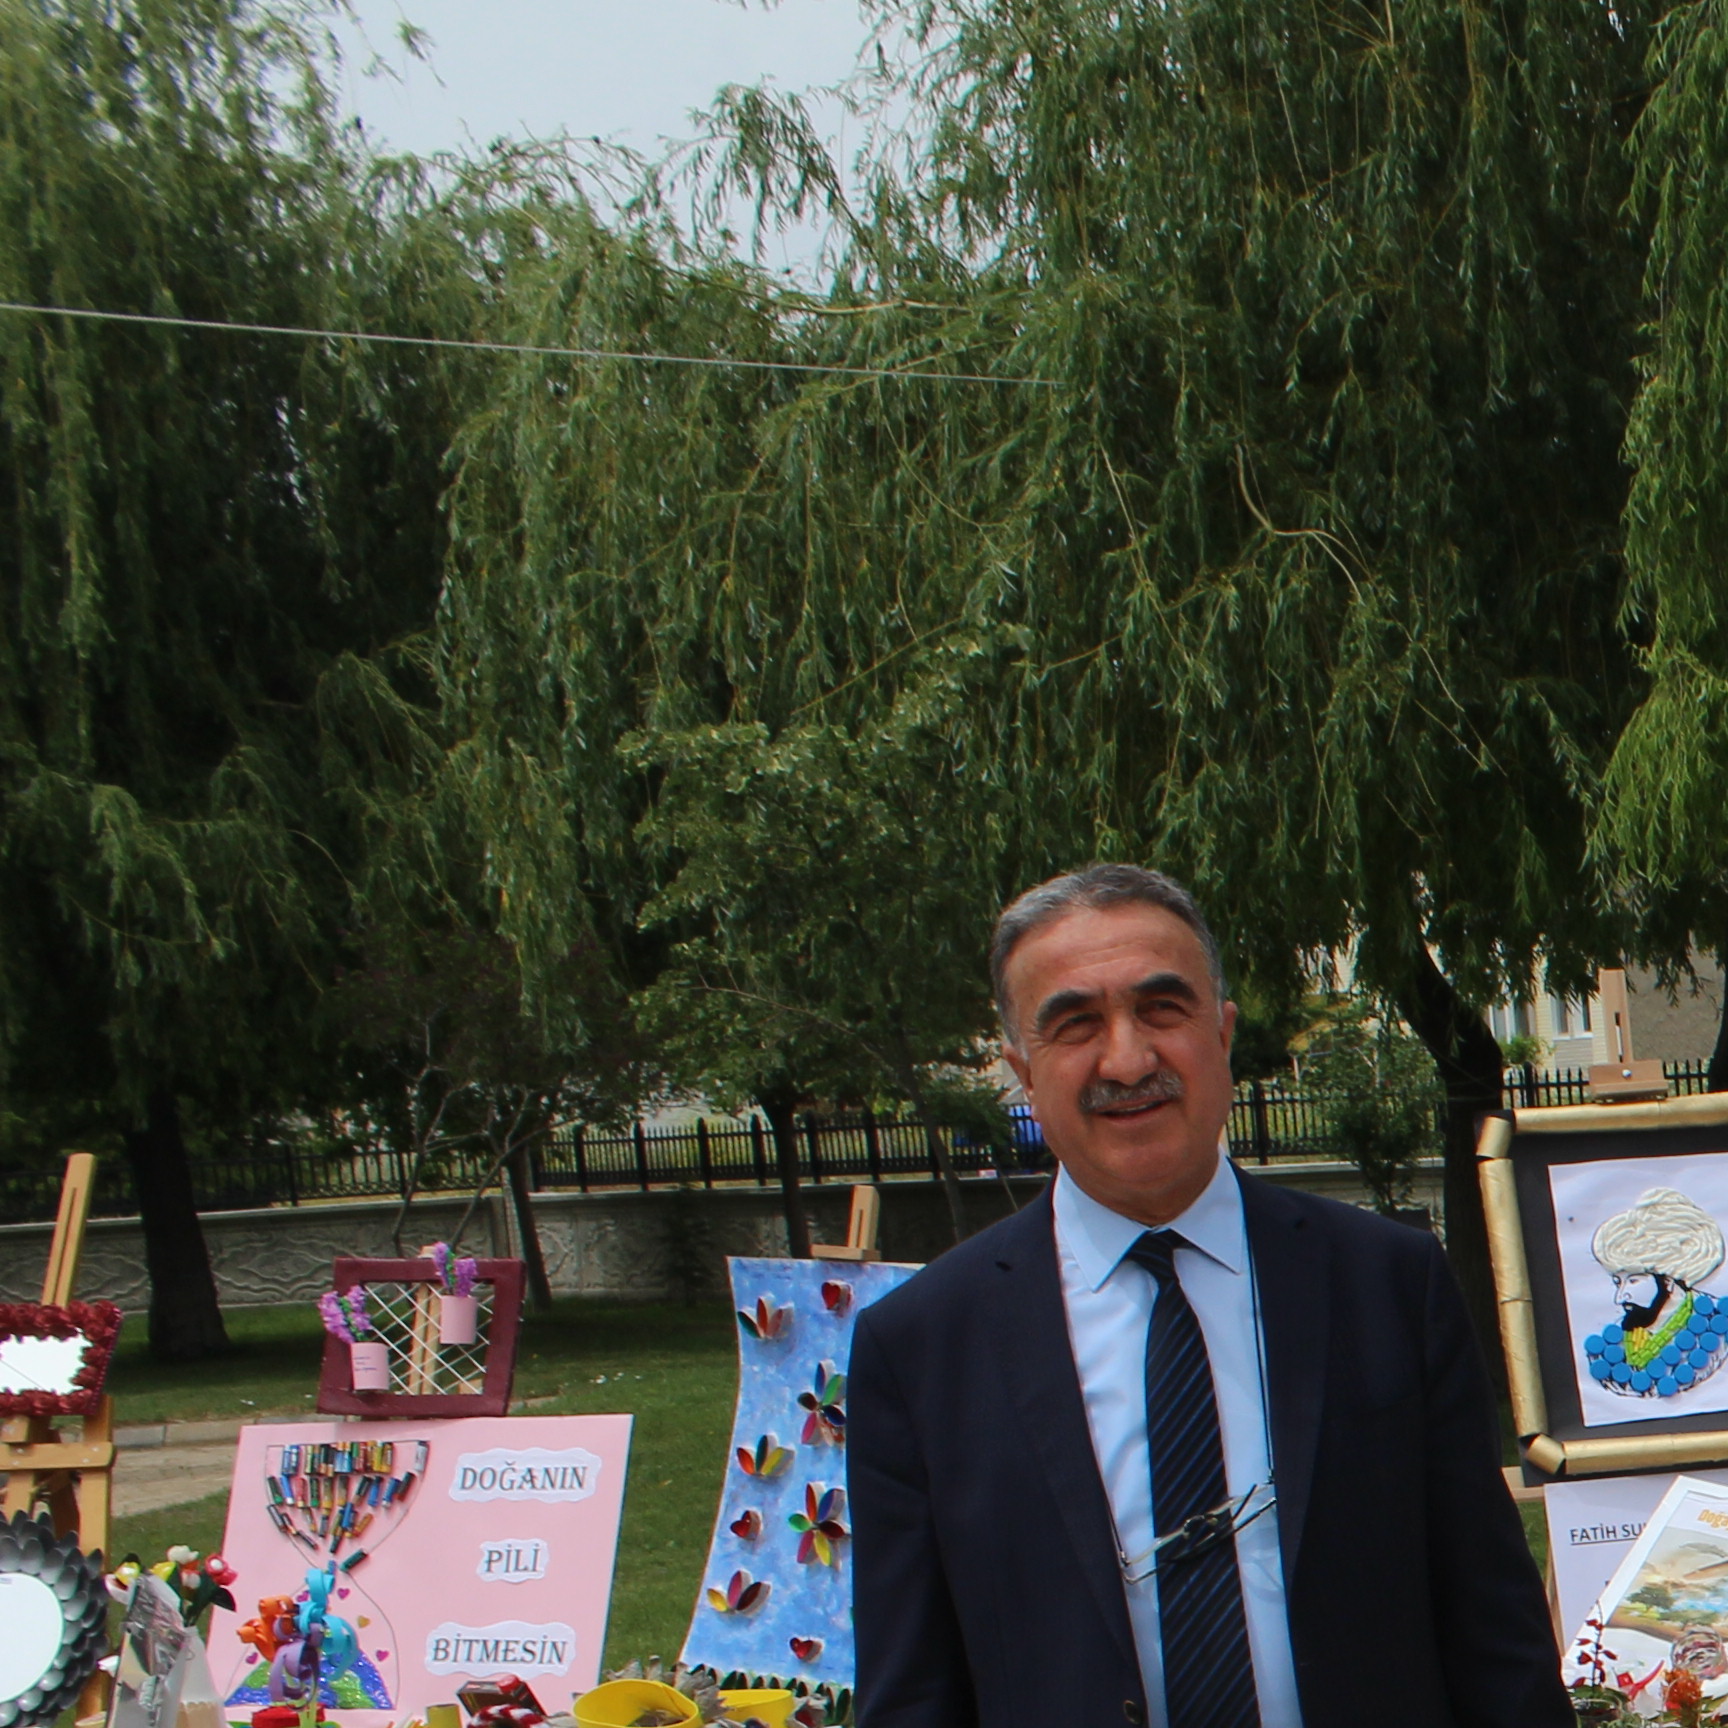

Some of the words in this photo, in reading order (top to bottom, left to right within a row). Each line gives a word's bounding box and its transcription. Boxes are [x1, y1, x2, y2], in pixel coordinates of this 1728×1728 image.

[459, 1461, 588, 1491] DOĞANIN
[1570, 1522, 1617, 1542] FATİH
[485, 1543, 542, 1573] PİLİ
[431, 1633, 568, 1666] BİTMESİN
